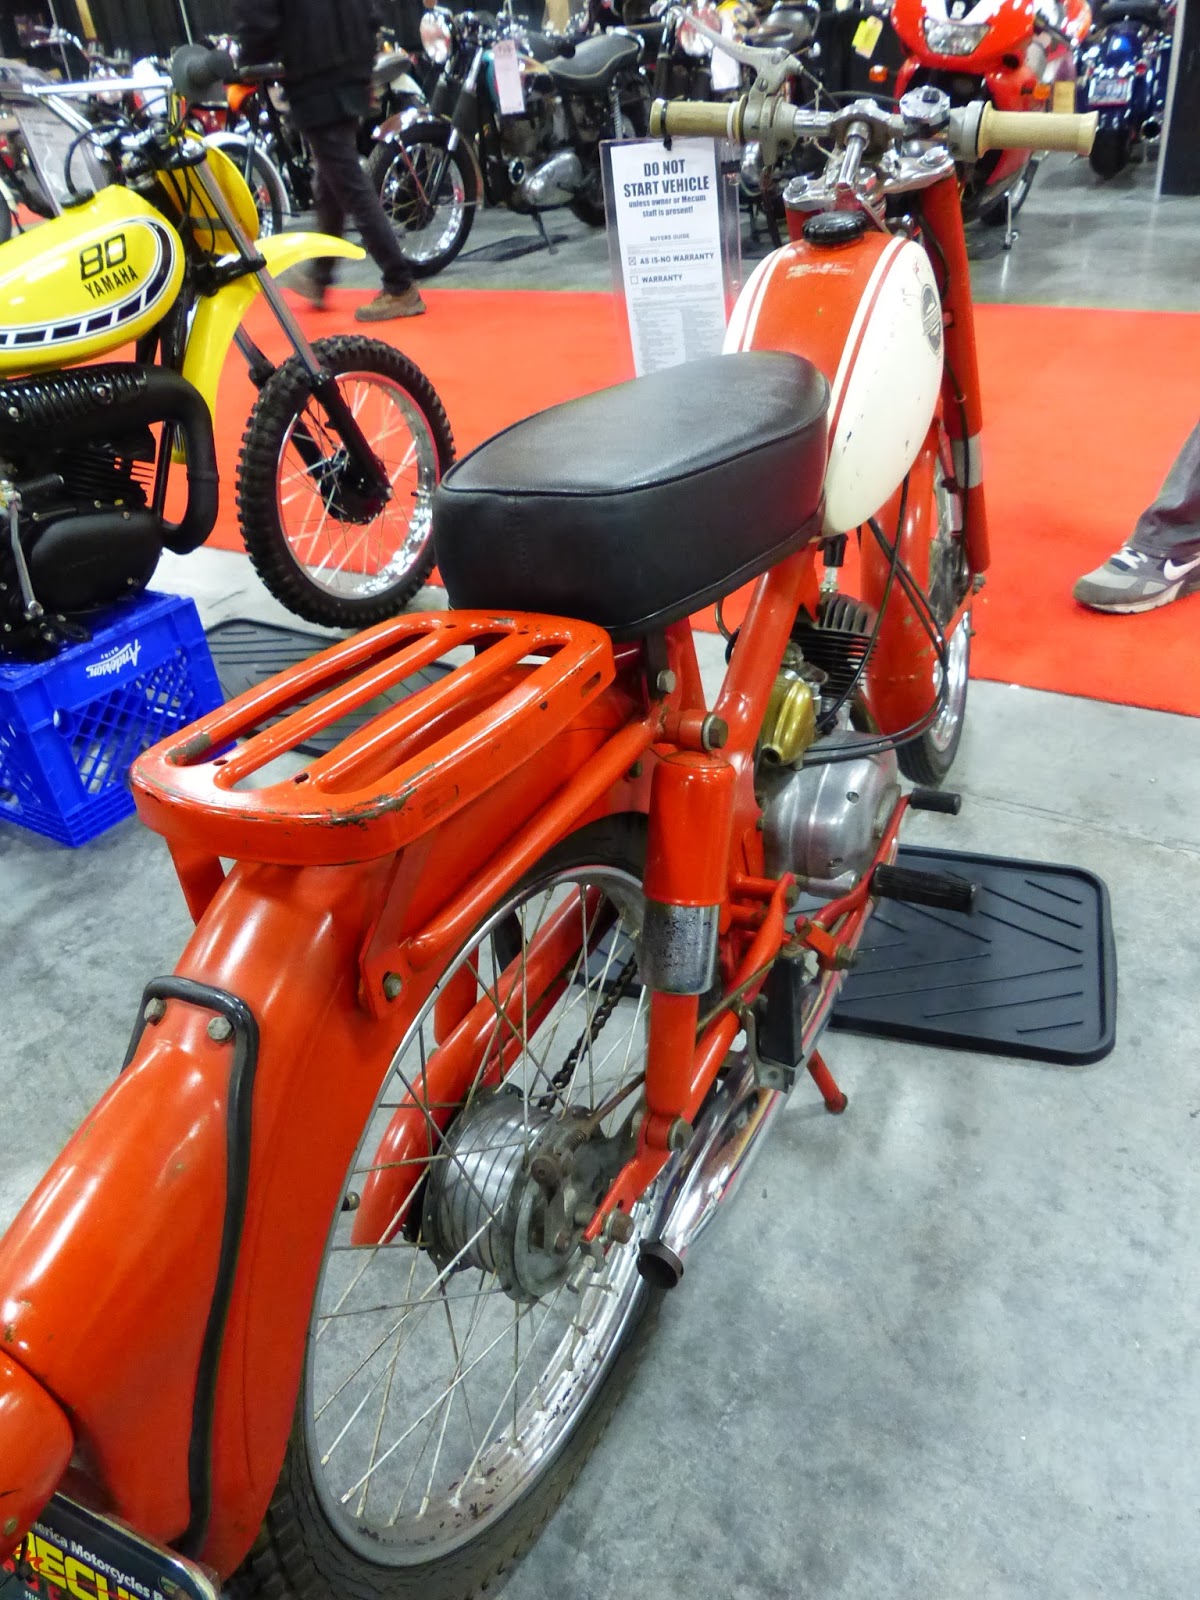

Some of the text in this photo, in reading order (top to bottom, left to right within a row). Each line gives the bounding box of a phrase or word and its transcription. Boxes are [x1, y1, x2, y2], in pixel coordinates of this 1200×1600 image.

[644, 159, 686, 177] DO NOT
[623, 176, 710, 198] START VEHICLE
[628, 198, 651, 208] unless
[651, 198, 672, 206] owner
[681, 194, 706, 203] Mecum
[642, 205, 694, 218] staff is present!
[649, 234, 672, 242] BUYERS
[80, 233, 126, 280] 80
[672, 252, 714, 262] WARRANTY
[84, 264, 139, 299] YAMAHA
[641, 274, 683, 283] WARRANTY
[86, 639, 141, 678] Anderson
[71, 1538, 151, 1599] Motorcycles
